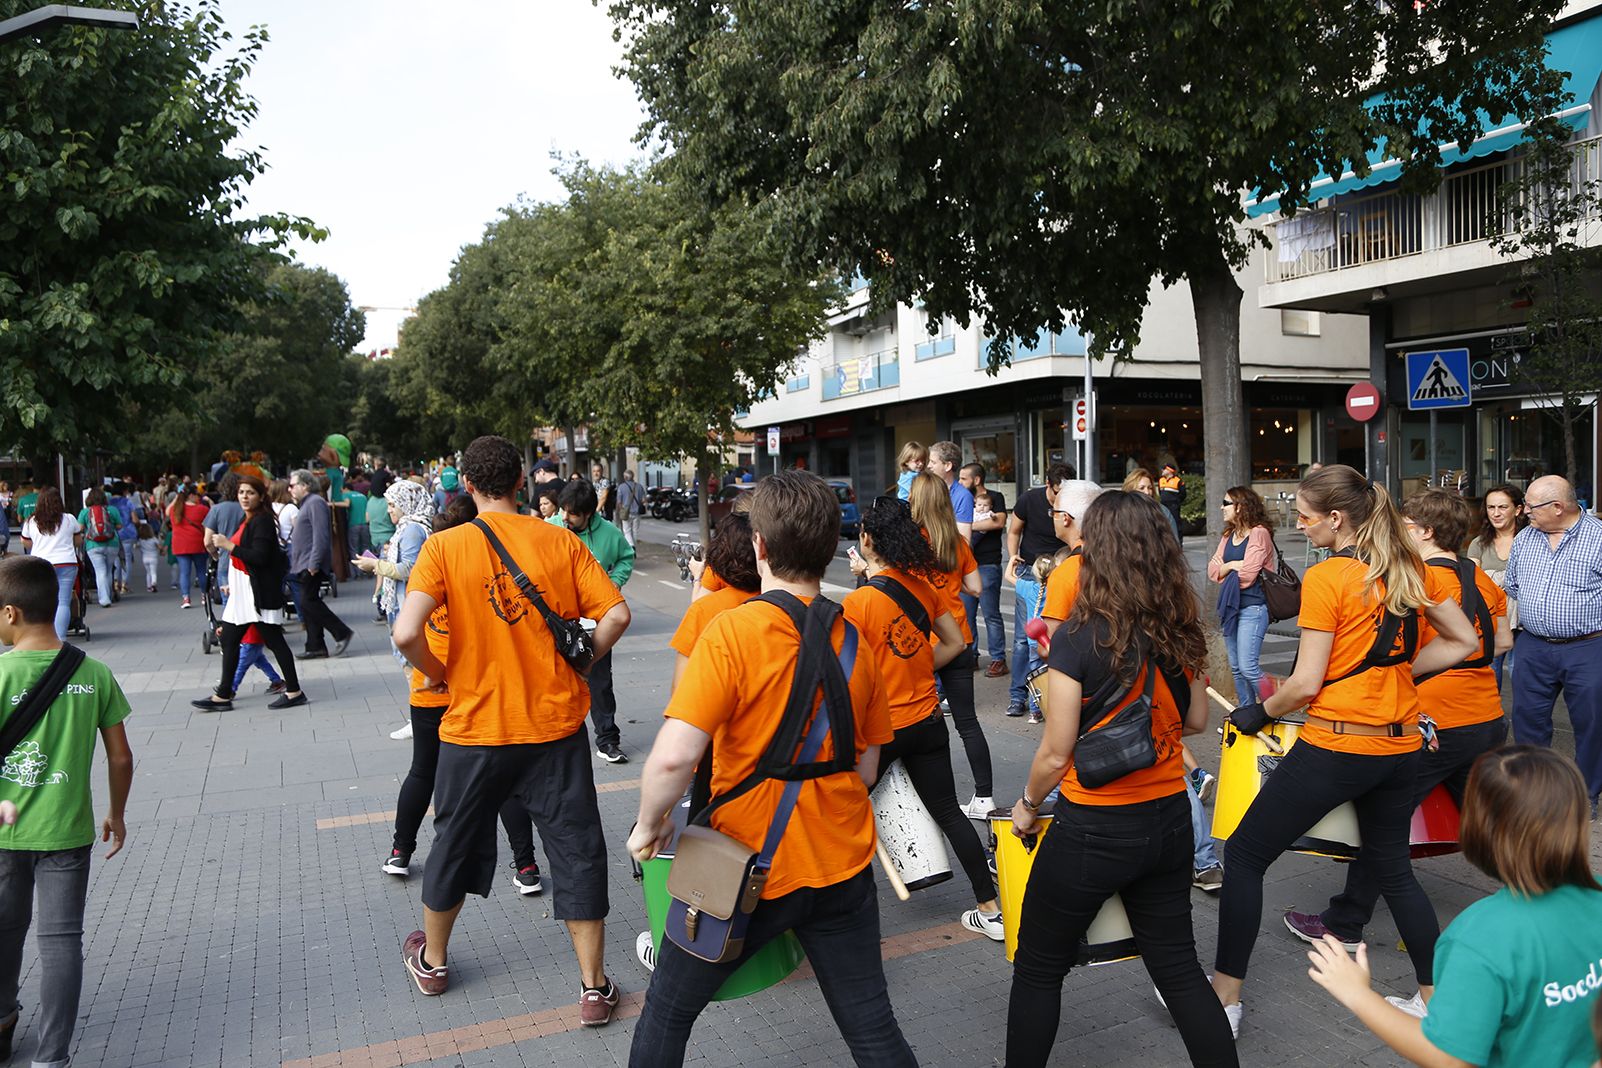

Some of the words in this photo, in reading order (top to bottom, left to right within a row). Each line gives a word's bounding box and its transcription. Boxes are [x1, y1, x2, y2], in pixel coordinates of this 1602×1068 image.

[1471, 359, 1507, 380] ON
[507, 600, 522, 618] PUM
[11, 688, 28, 705] SÓ
[66, 684, 95, 694] PINS
[1156, 738, 1168, 755] UM
[1543, 958, 1602, 1007] Socd
